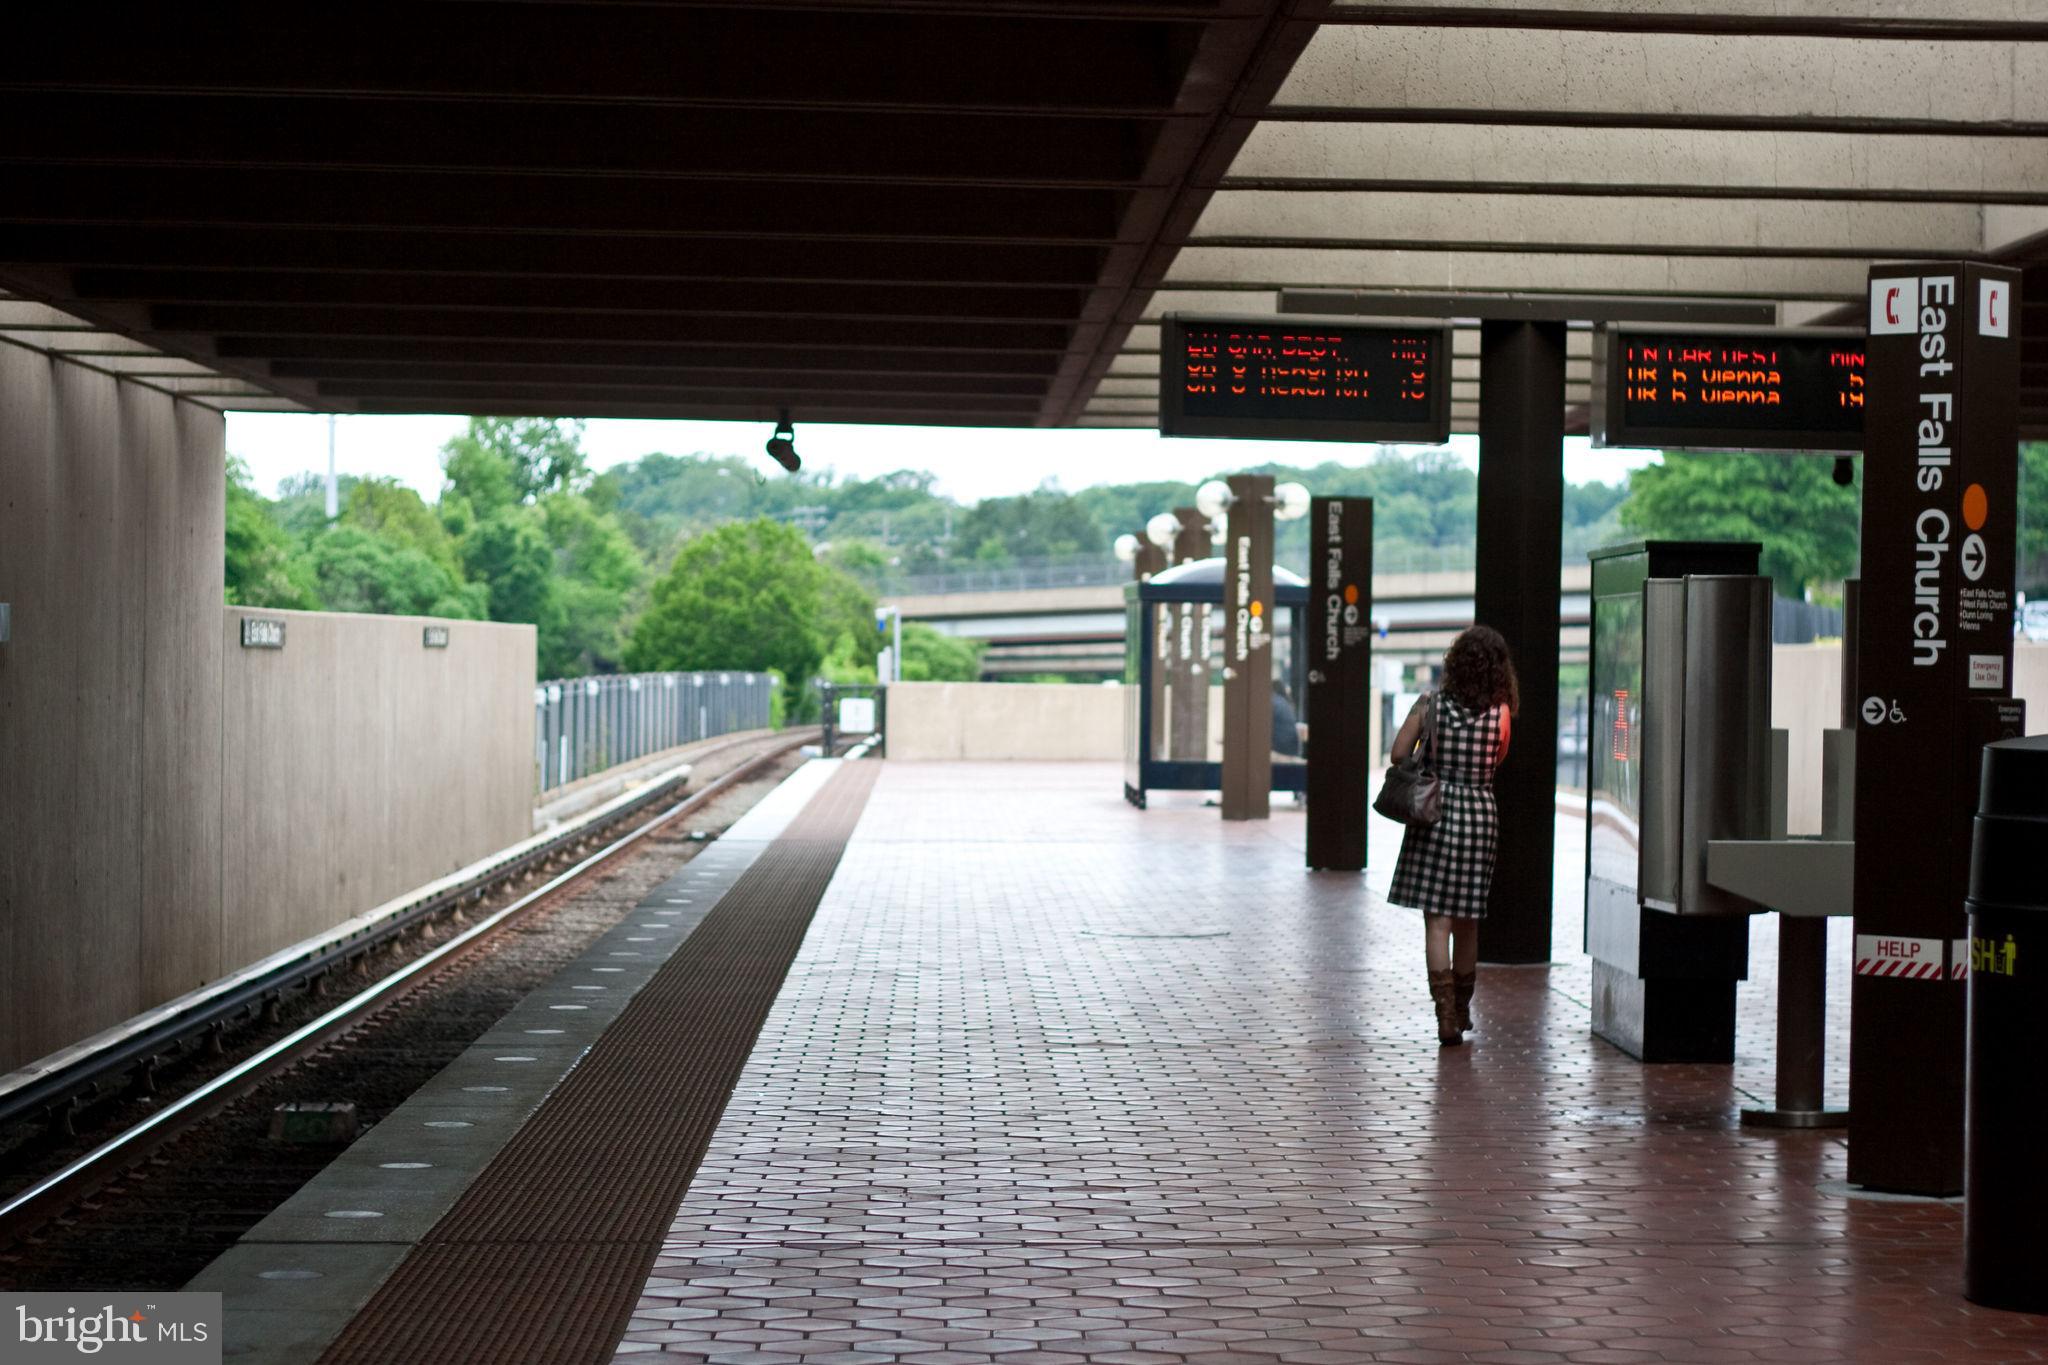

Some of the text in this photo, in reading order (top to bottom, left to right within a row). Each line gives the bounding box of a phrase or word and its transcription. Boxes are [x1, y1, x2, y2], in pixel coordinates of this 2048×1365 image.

[1913, 276, 1954, 666] East Falls Church
[1326, 501, 1342, 660] East Falls Church
[1973, 661, 2000, 671] Emergency
[1876, 940, 1921, 958] HELP
